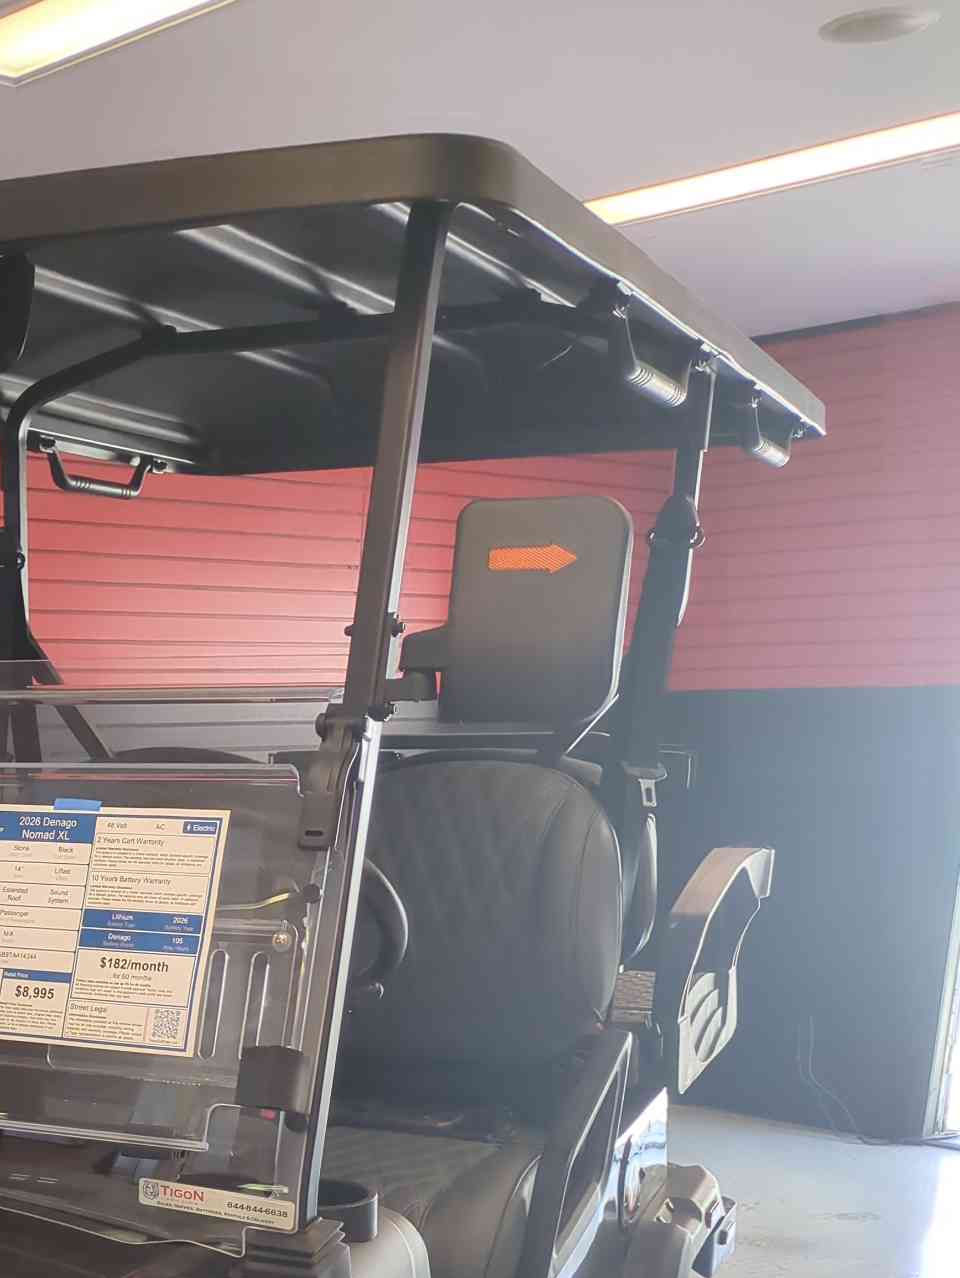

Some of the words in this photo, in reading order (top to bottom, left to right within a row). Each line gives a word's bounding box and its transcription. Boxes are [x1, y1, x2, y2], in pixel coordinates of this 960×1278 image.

[19, 816, 41, 827] 2026
[43, 817, 77, 830] Denago
[22, 829, 55, 841] Nomad
[57, 831, 71, 841] XL
[99, 956, 169, 973] $182/month
[14, 985, 55, 1000] $8,995
[160, 1184, 205, 1202] TIGON
